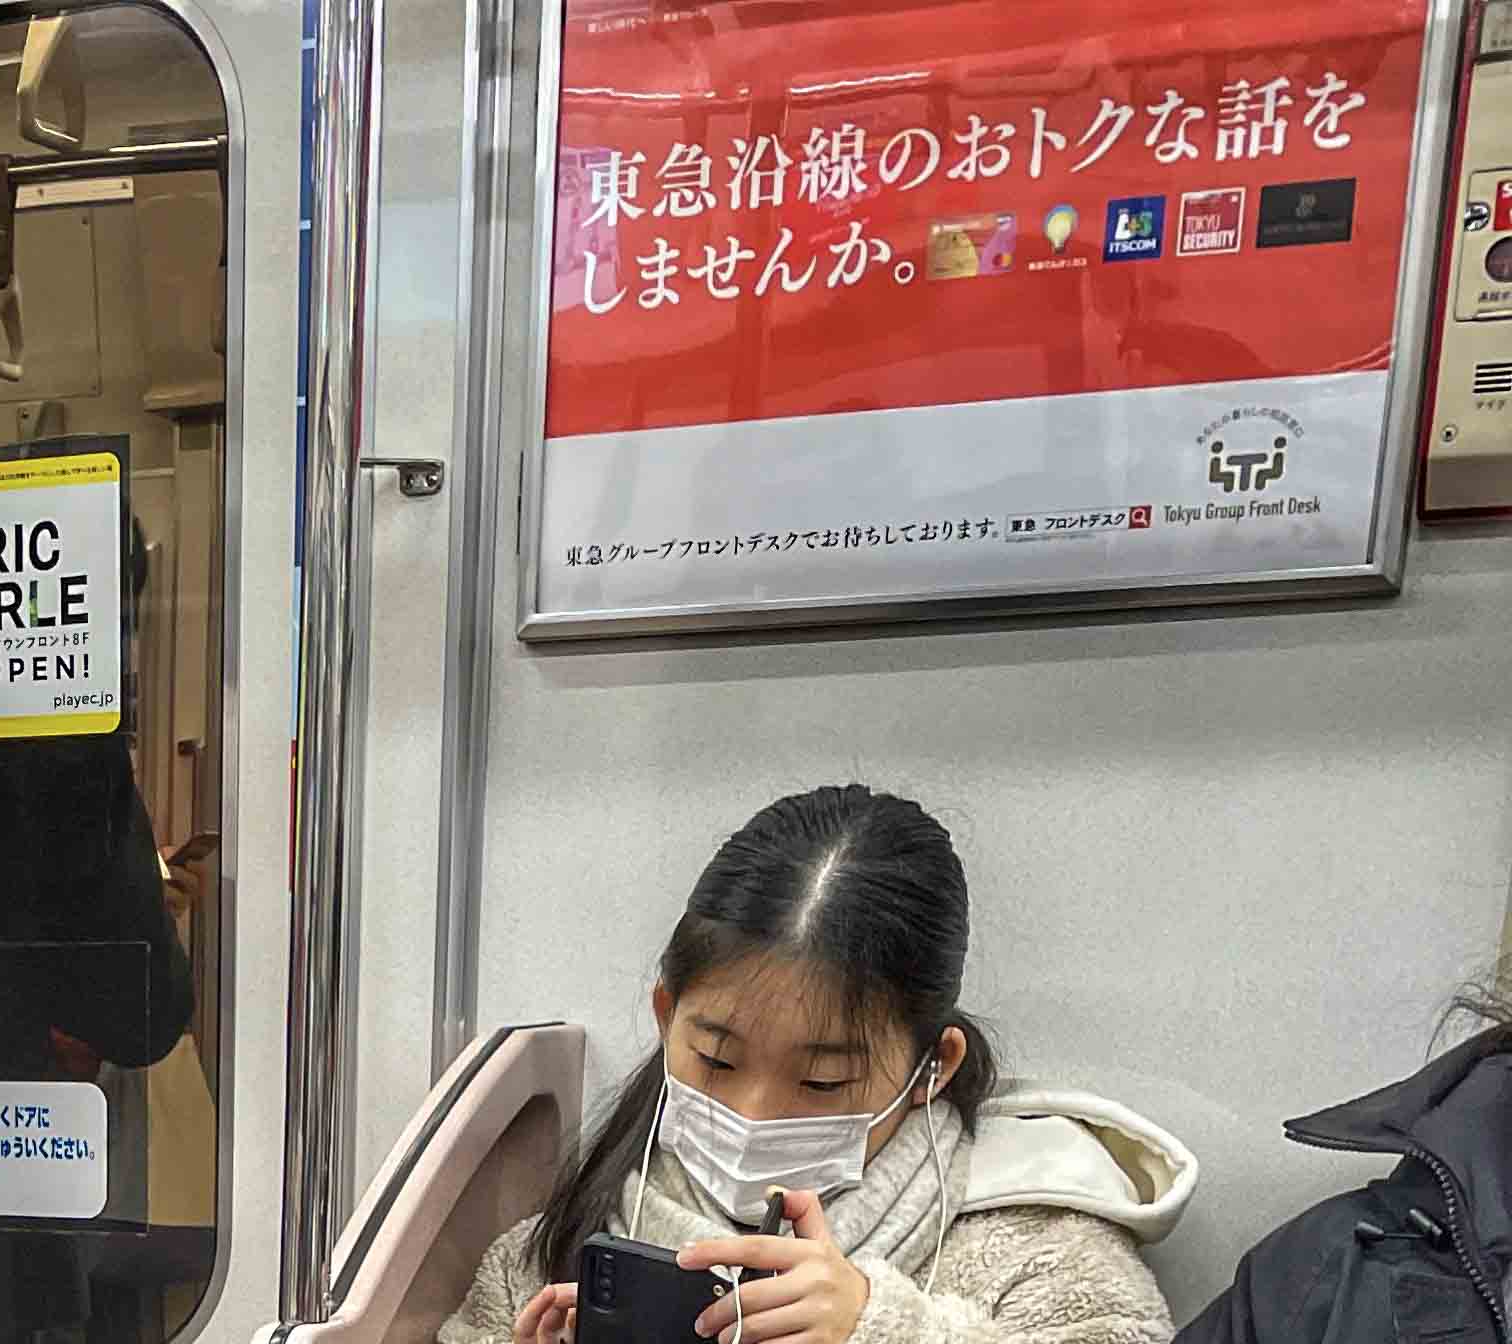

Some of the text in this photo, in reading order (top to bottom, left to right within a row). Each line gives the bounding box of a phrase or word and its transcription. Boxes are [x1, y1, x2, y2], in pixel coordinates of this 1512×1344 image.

[583, 72, 1366, 227] 東急沿線のおトクな話を
[1185, 214, 1220, 232] TOKYU
[1109, 239, 1156, 253] ITSCOM
[1182, 229, 1235, 250] SECURITY
[584, 221, 915, 314] しませんか。
[1164, 496, 1321, 526] Tokyu Group Front Desk
[567, 517, 999, 567] 東急グループフロントデスクでお待ちしております。
[53, 691, 114, 709] playec.jp
